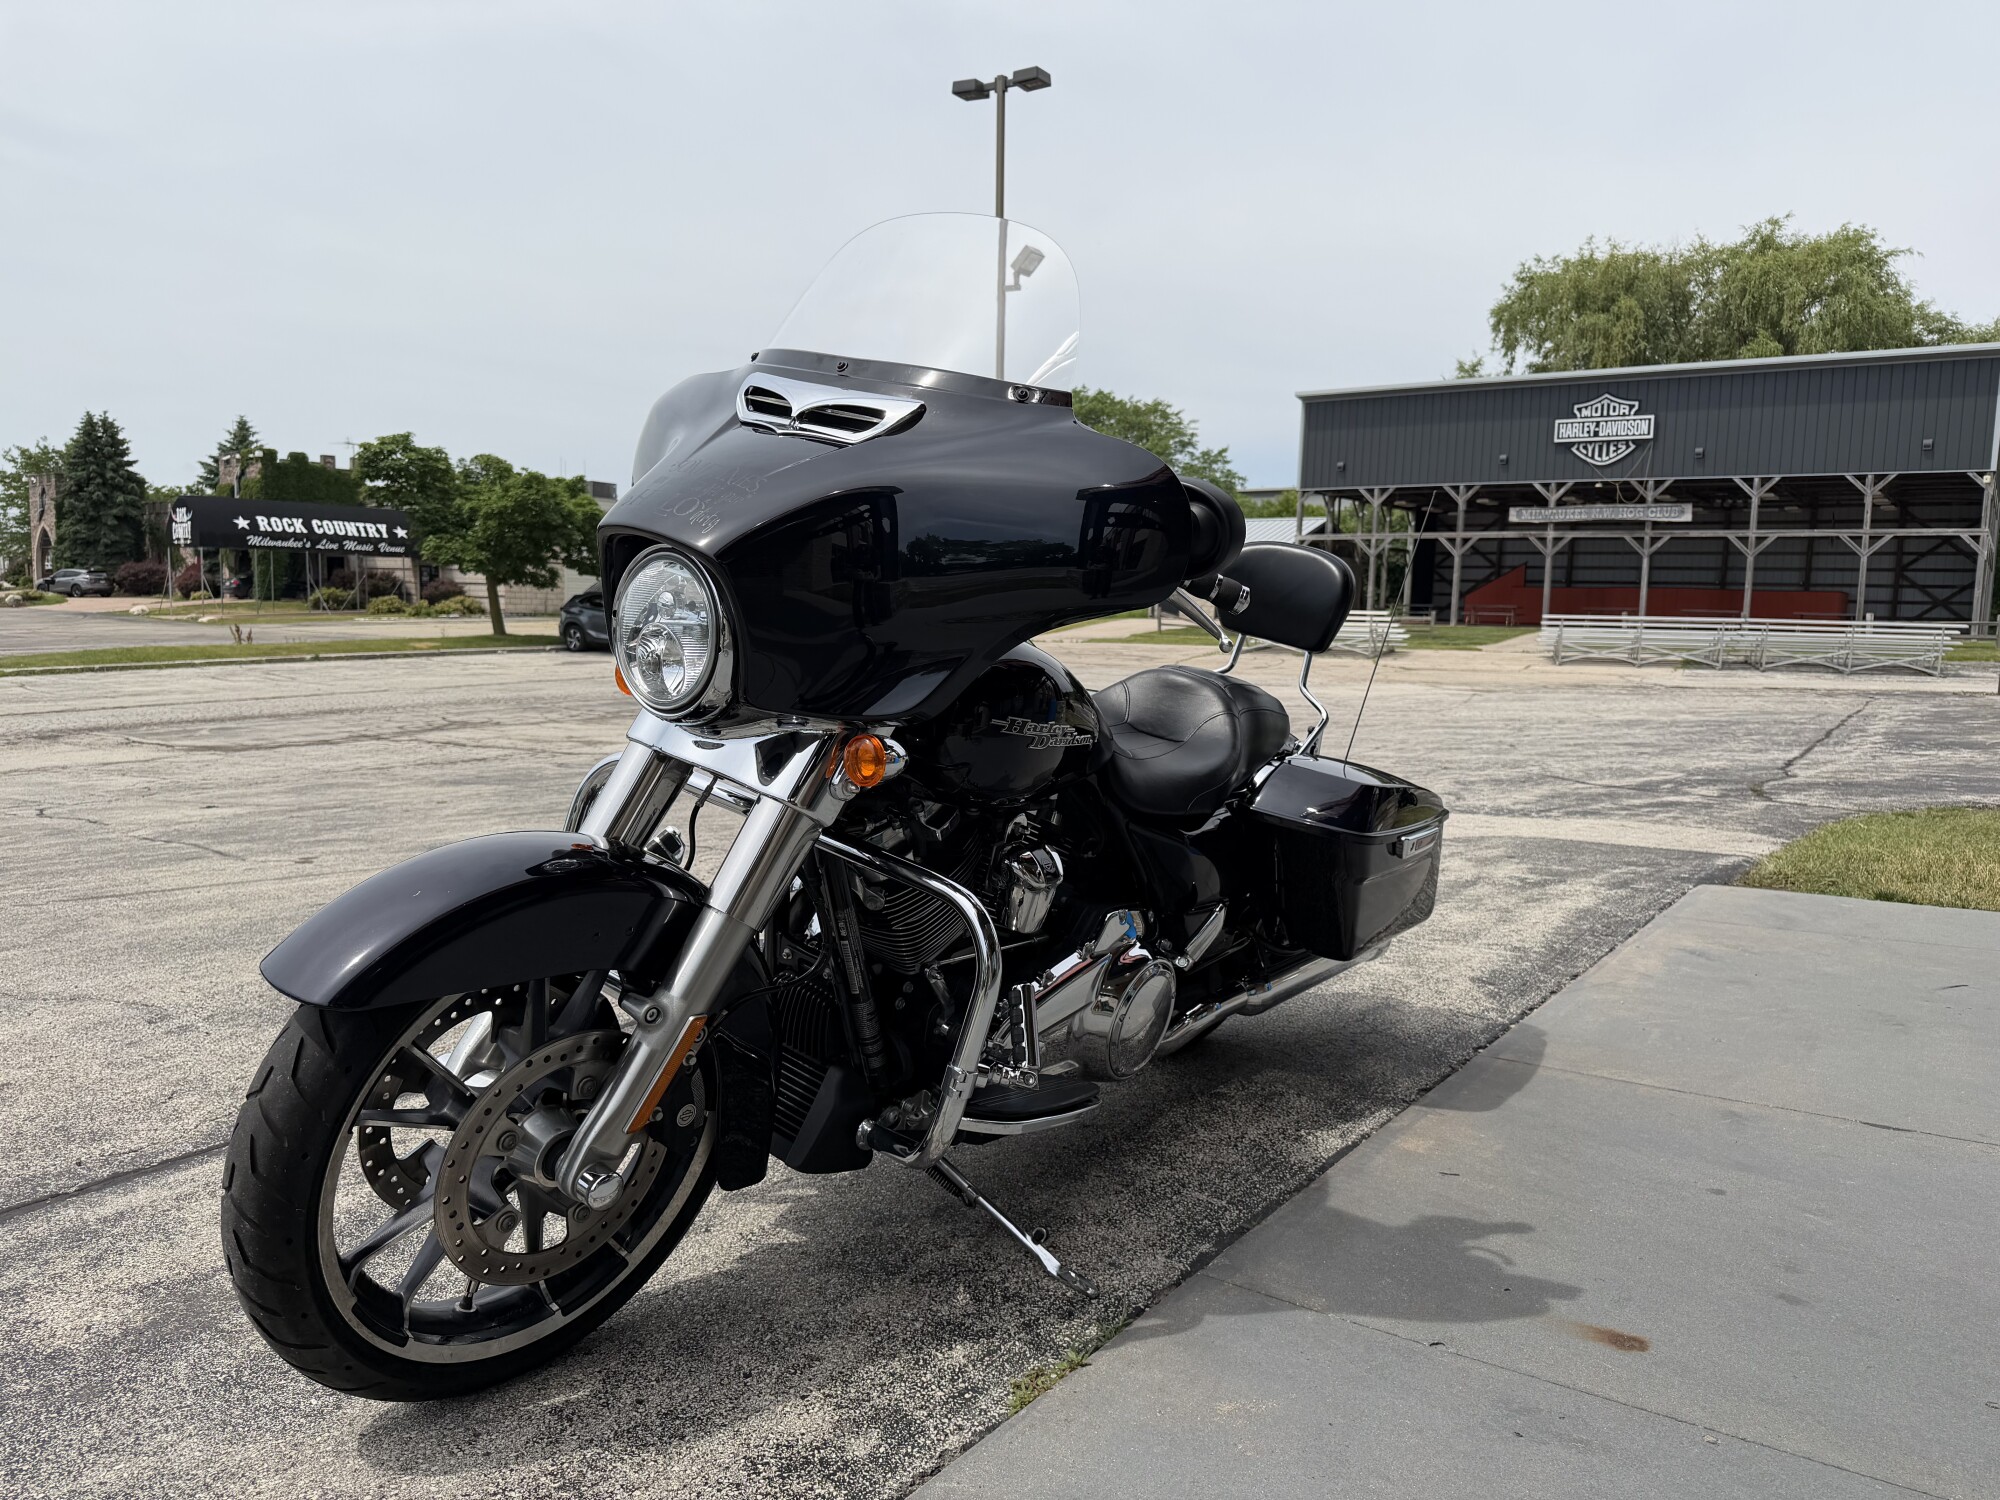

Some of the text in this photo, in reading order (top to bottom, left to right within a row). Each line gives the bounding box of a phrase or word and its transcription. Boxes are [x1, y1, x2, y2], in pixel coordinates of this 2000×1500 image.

[1581, 399, 1630, 417] MOTOR
[1558, 419, 1650, 438] HARLEY-DAVIDSON
[1579, 441, 1627, 461] CYCLES
[176, 506, 187, 522] ROCK
[1521, 508, 1588, 521] MILWAUKEE
[1618, 507, 1644, 519] HOG
[1648, 506, 1680, 518] CLUB
[172, 521, 192, 540] COUNTRY
[255, 515, 389, 539] ROCK COUNTRY
[246, 535, 405, 553] Milwaukee's Live Music Venue
[1028, 732, 1093, 749] Davidson
